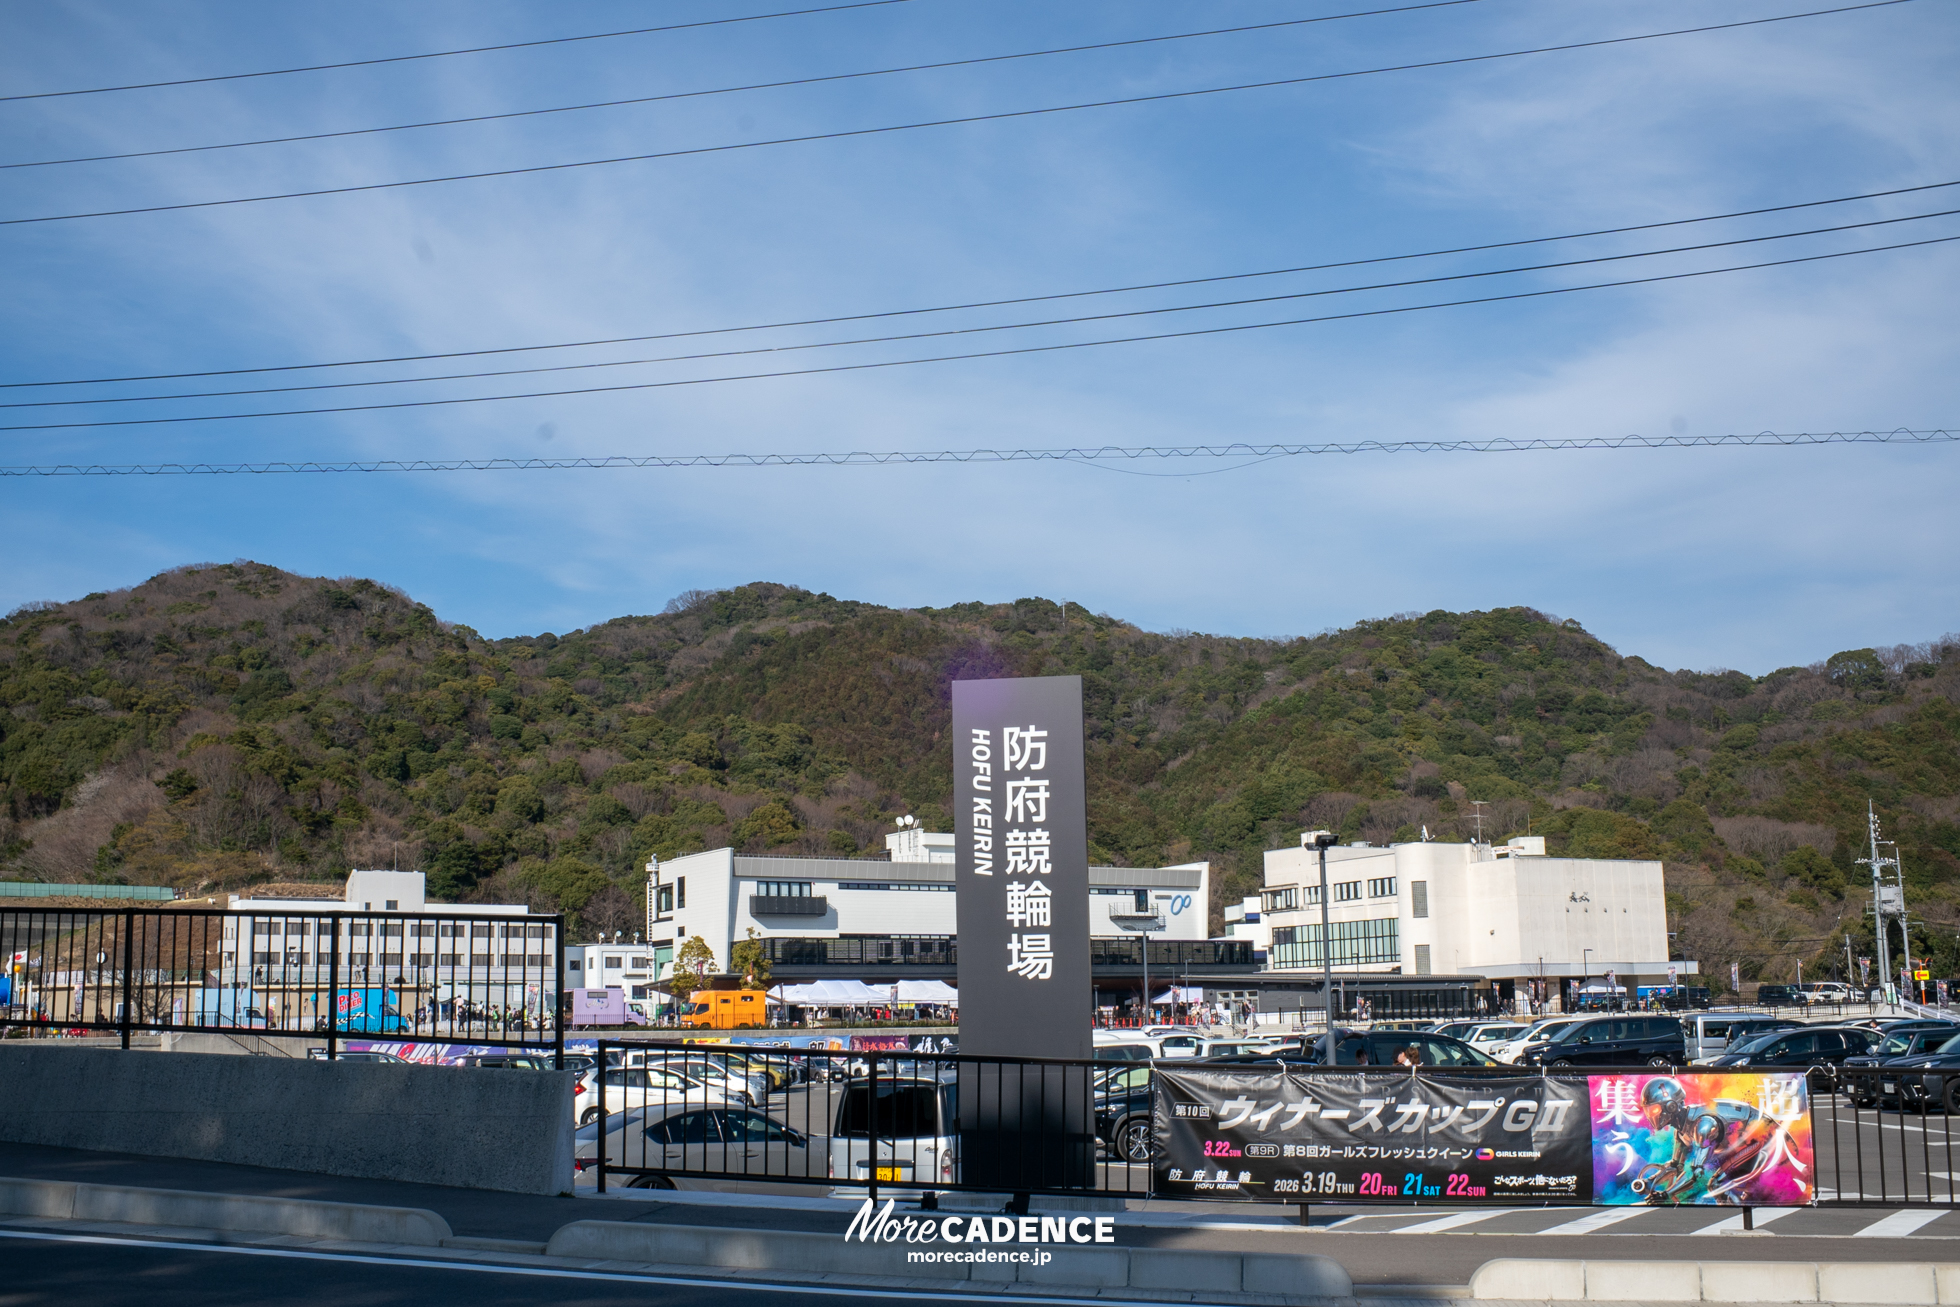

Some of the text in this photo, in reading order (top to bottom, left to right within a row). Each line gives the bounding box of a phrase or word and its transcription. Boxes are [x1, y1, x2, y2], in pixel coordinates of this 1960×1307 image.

[971, 728, 993, 876] HOFU KEIRIN
[1003, 725, 1054, 980] 防府競輪場
[1175, 1104, 1210, 1118] 第10回
[1596, 1079, 1642, 1177] 集う
[1249, 1146, 1275, 1156] 第9R
[1283, 1145, 1473, 1159] 第8回ガールズフレッシュクイーン
[1495, 1150, 1517, 1158] GIRLS
[1194, 1182, 1215, 1190] HOFU
[1274, 1179, 1299, 1193] 2026
